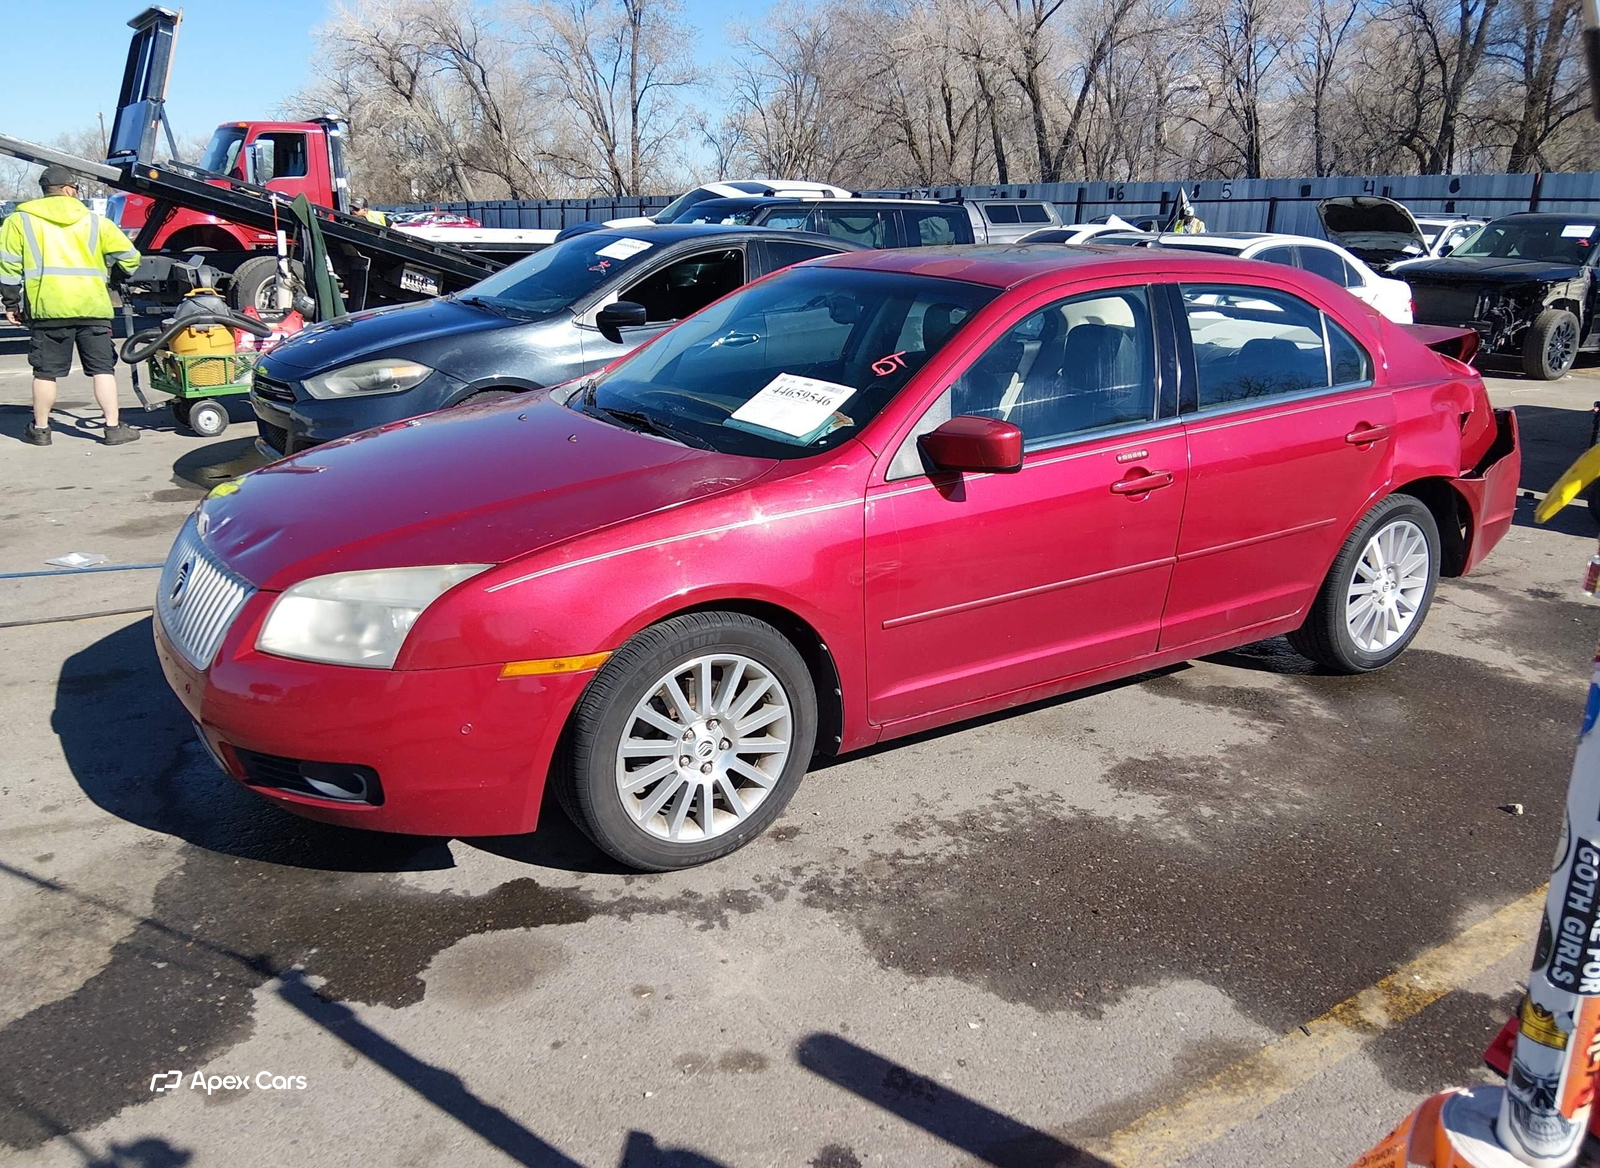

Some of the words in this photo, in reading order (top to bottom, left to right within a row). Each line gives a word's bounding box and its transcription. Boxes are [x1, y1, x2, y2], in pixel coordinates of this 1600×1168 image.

[989, 188, 998, 199] 7
[1116, 185, 1125, 201] 6
[1222, 182, 1233, 200] 5
[1363, 180, 1375, 197] 4
[772, 385, 832, 407] 44659546
[1568, 847, 1599, 913] GOTH
[1552, 916, 1587, 985] GIRLS
[1578, 948, 1600, 993] FOR
